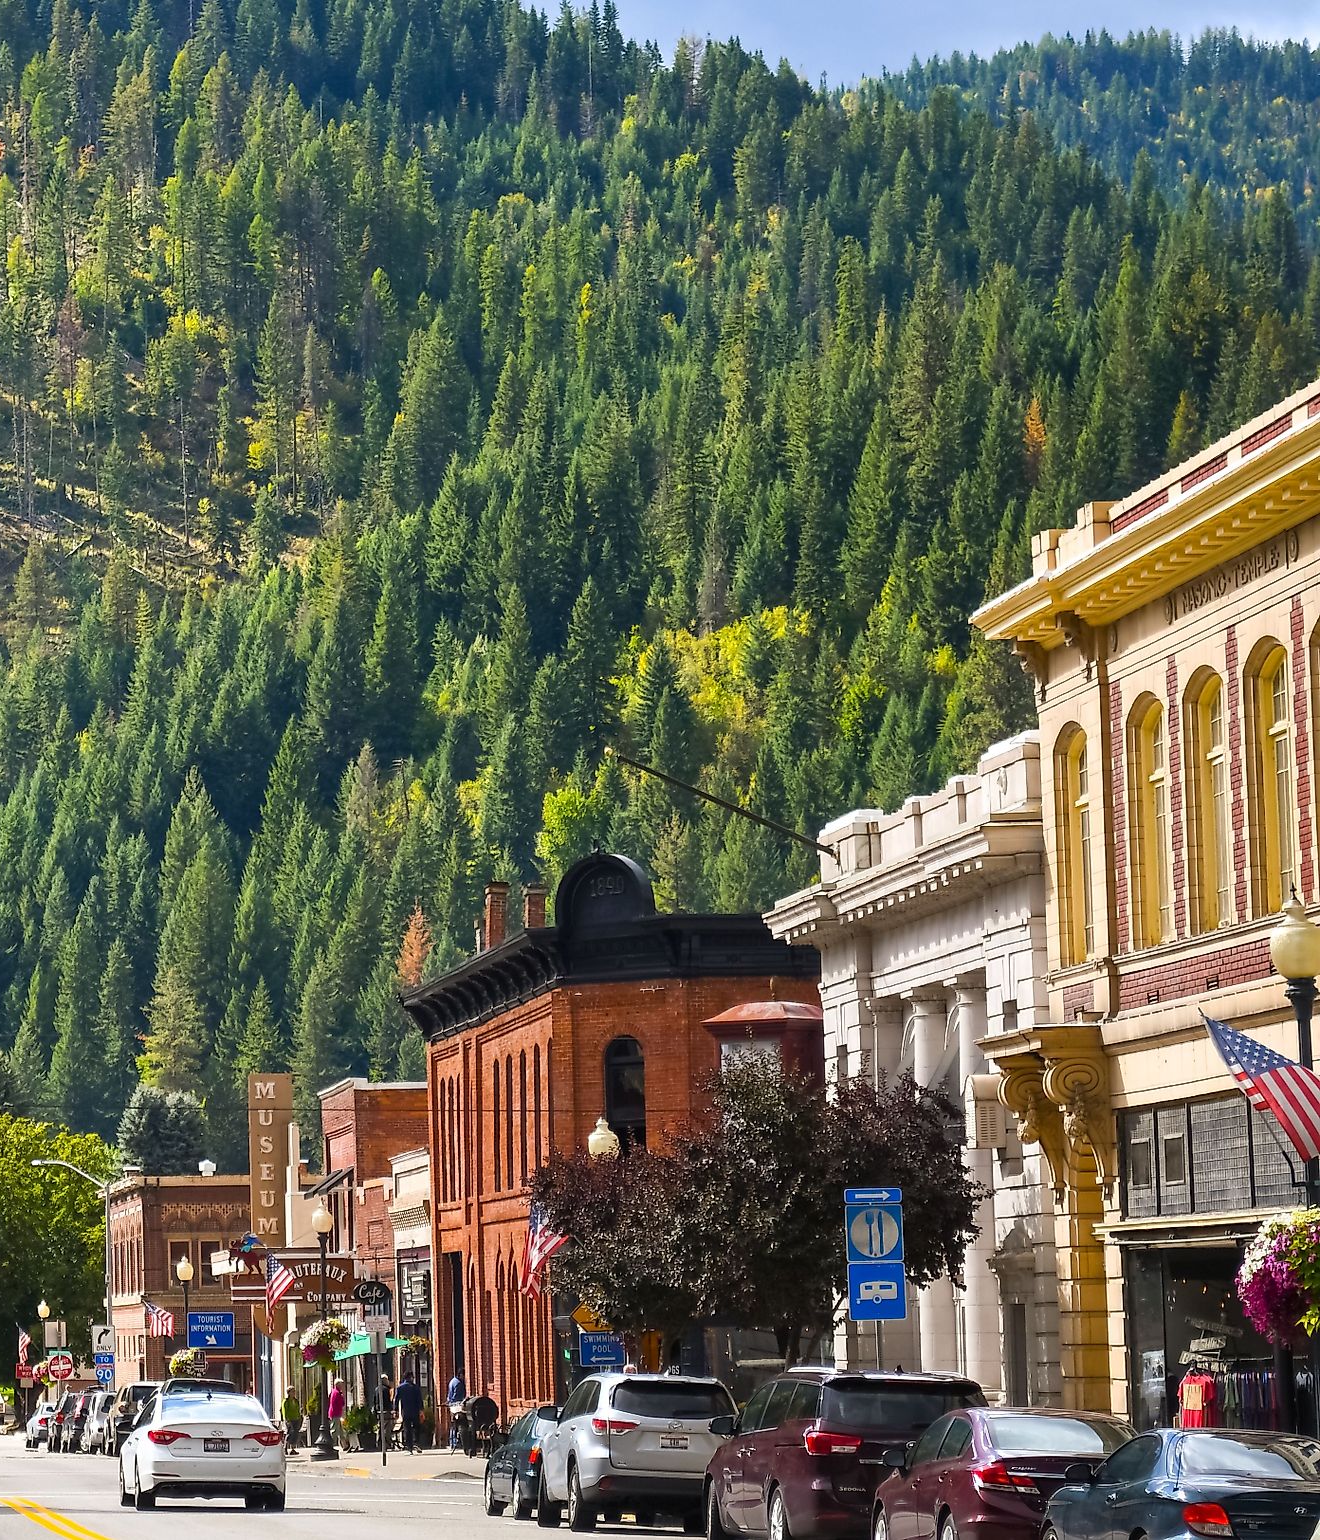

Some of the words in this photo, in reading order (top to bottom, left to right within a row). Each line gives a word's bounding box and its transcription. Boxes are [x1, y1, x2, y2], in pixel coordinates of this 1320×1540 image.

[1182, 572, 1227, 614] MASONIC
[1231, 545, 1279, 588] TEMPLE
[254, 1081, 279, 1235] MUSEUM
[197, 1315, 224, 1323] TOURIST
[190, 1324, 231, 1332] INFORMATION
[592, 1345, 612, 1353] POOL
[96, 1369, 112, 1380] 90
